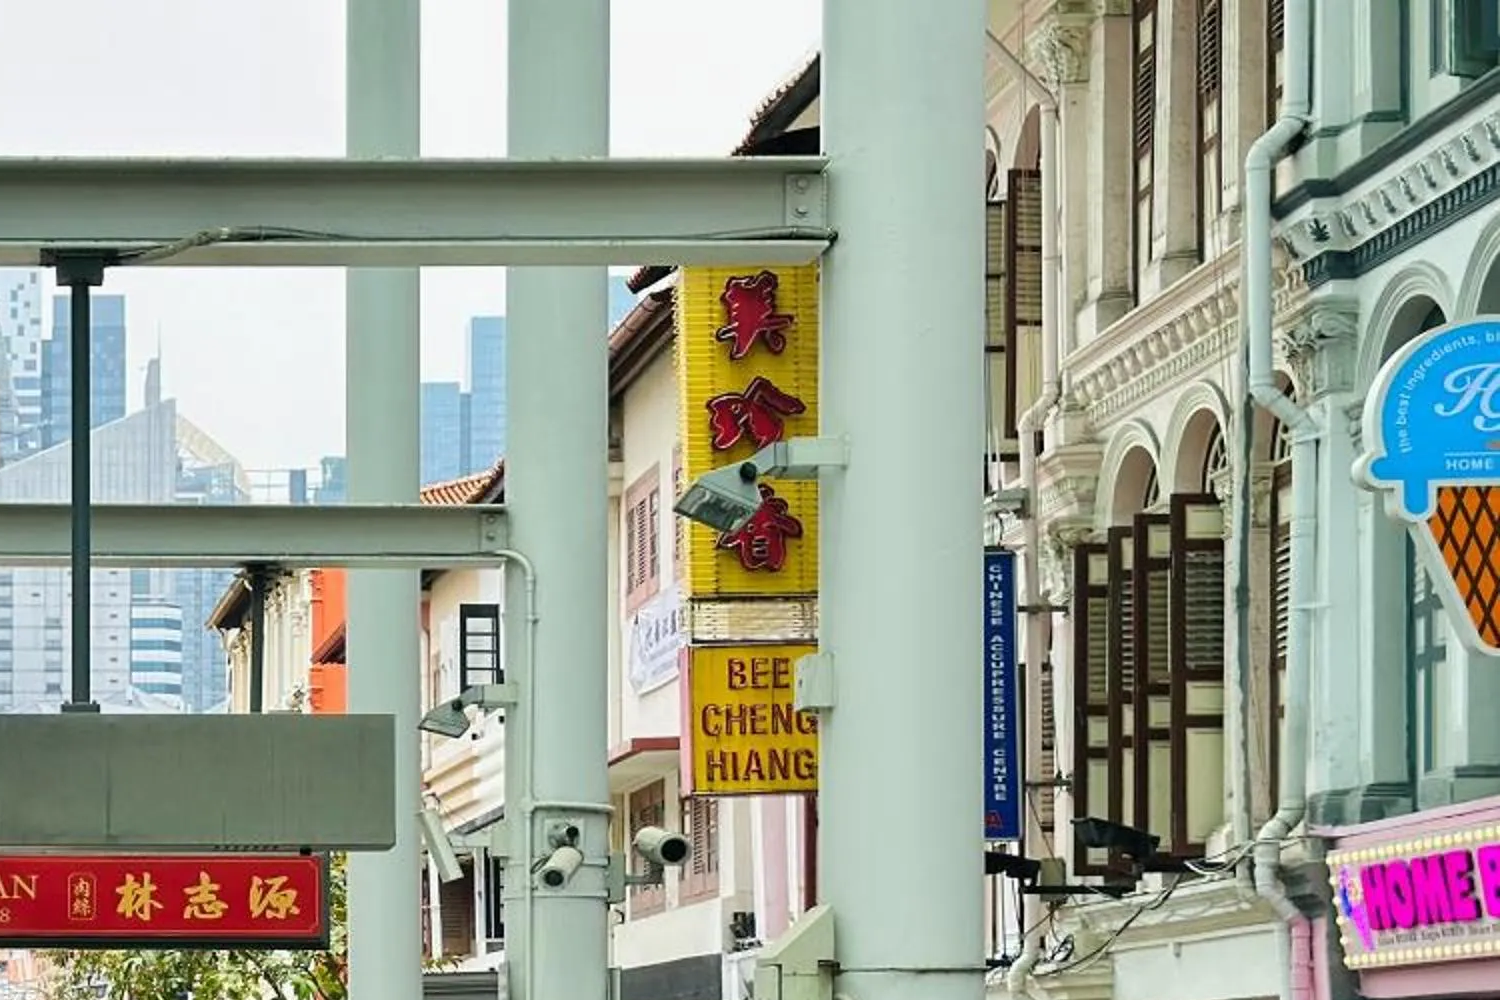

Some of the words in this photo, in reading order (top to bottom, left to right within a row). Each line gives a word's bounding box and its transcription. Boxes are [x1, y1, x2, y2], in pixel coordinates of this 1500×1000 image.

[1445, 458, 1494, 470] HOME
[988, 564, 1002, 625] CHINESE
[727, 657, 790, 690] BEE
[701, 703, 818, 737] CHENG
[706, 749, 817, 782] HIANG
[993, 748, 1007, 801] CENTRE
[1361, 850, 1480, 930] HOME
